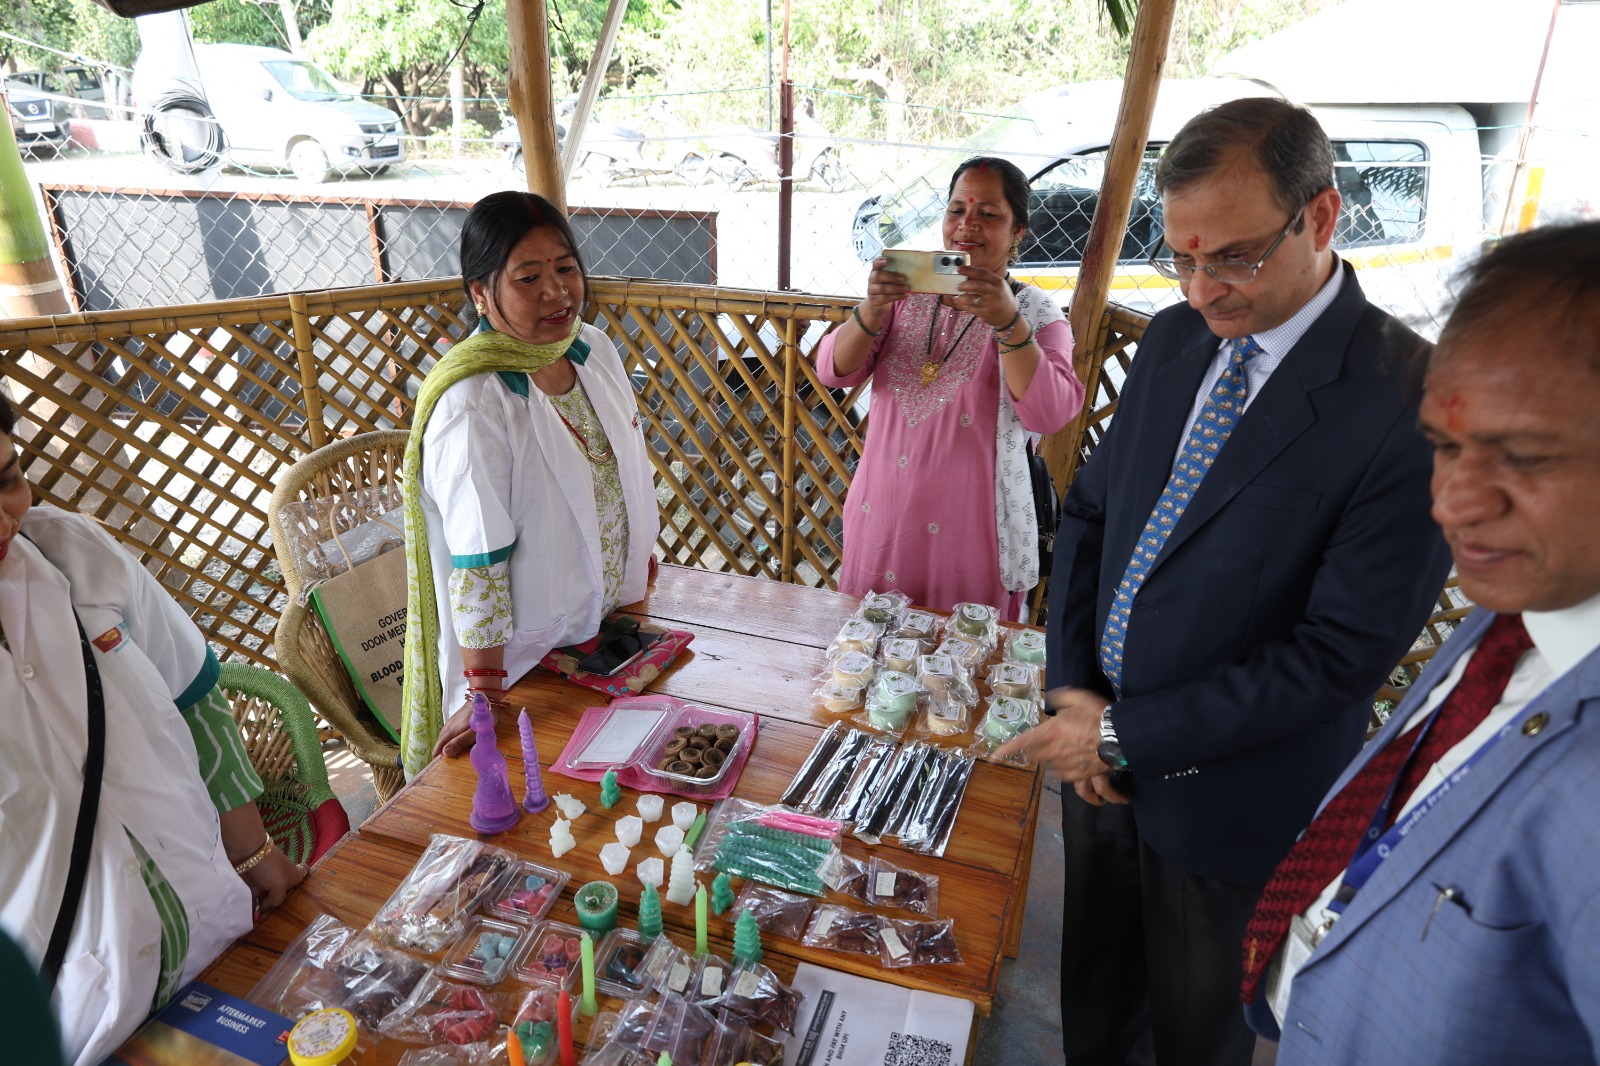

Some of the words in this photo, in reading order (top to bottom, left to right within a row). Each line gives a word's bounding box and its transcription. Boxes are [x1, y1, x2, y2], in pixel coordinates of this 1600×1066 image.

[378, 607, 407, 628] GOVER
[361, 632, 387, 651] DOON
[387, 621, 407, 639] MED
[370, 660, 403, 682] BLOOD
[216, 1015, 250, 1035] BUSINESS
[217, 1004, 267, 1029] AFTERMARKET
[825, 1049, 834, 1062] AND
[833, 1022, 843, 1037] WITH
[839, 1010, 847, 1022] ANY
